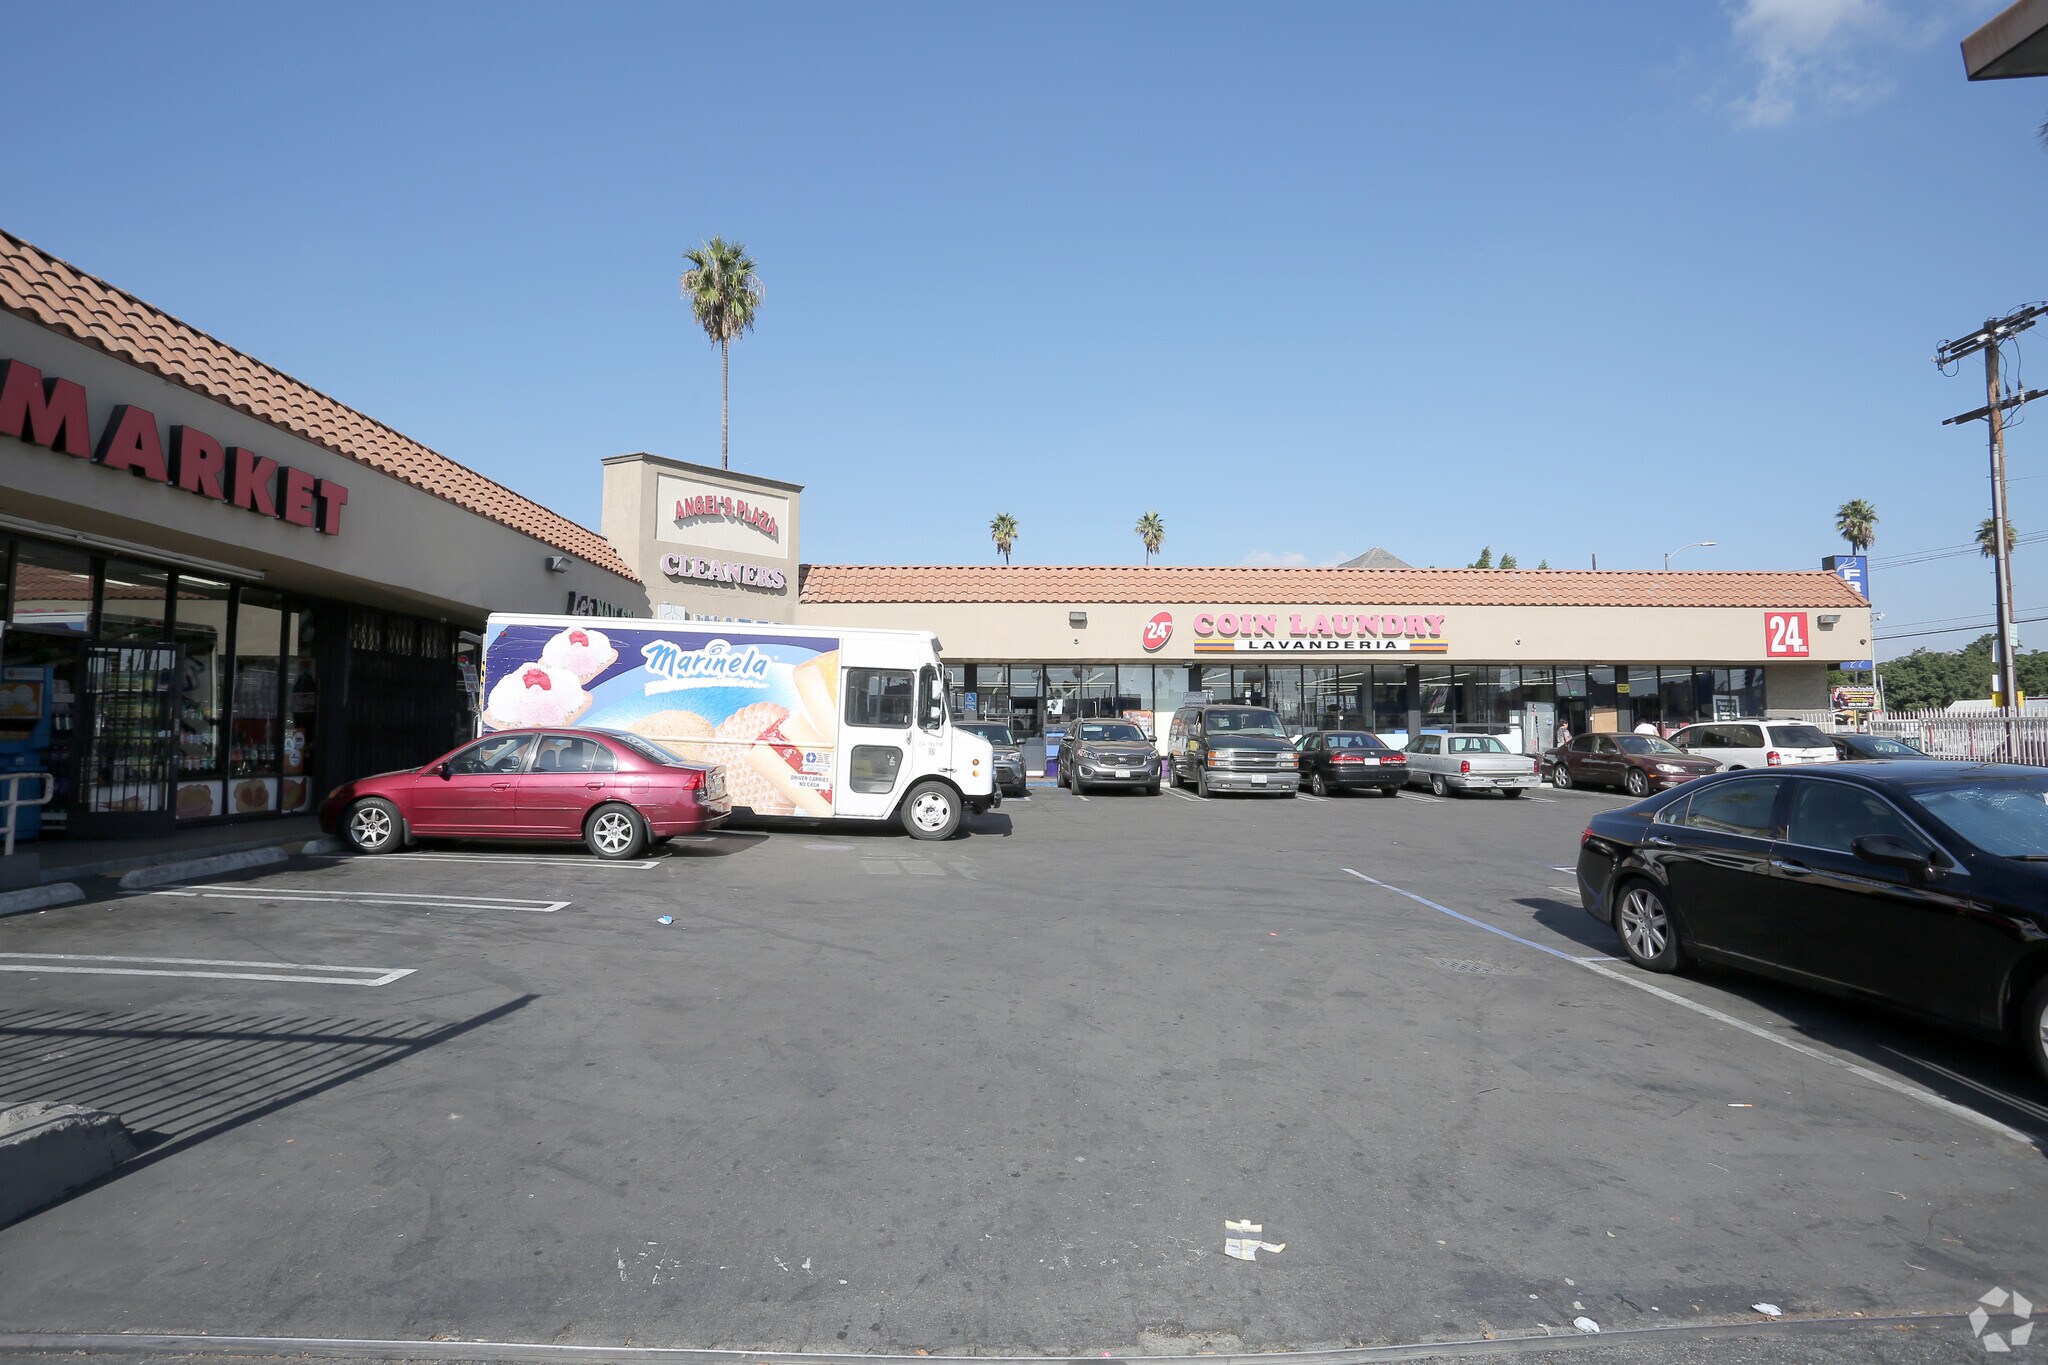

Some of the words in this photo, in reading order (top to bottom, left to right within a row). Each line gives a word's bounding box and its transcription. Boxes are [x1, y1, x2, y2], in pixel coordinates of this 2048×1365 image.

[0, 358, 349, 536] MARKET
[674, 495, 733, 521] ANGEL'S
[737, 499, 778, 537] PLAZA
[660, 552, 786, 589] CLEANERS
[1147, 621, 1167, 639] 24
[1193, 613, 1278, 636] COIN
[1289, 613, 1446, 637] LAUNDRY
[1769, 615, 1804, 653] 24
[646, 643, 768, 677] Marinela
[1249, 640, 1397, 650] LAVANDERIA
[809, 775, 829, 783] CARRIES
